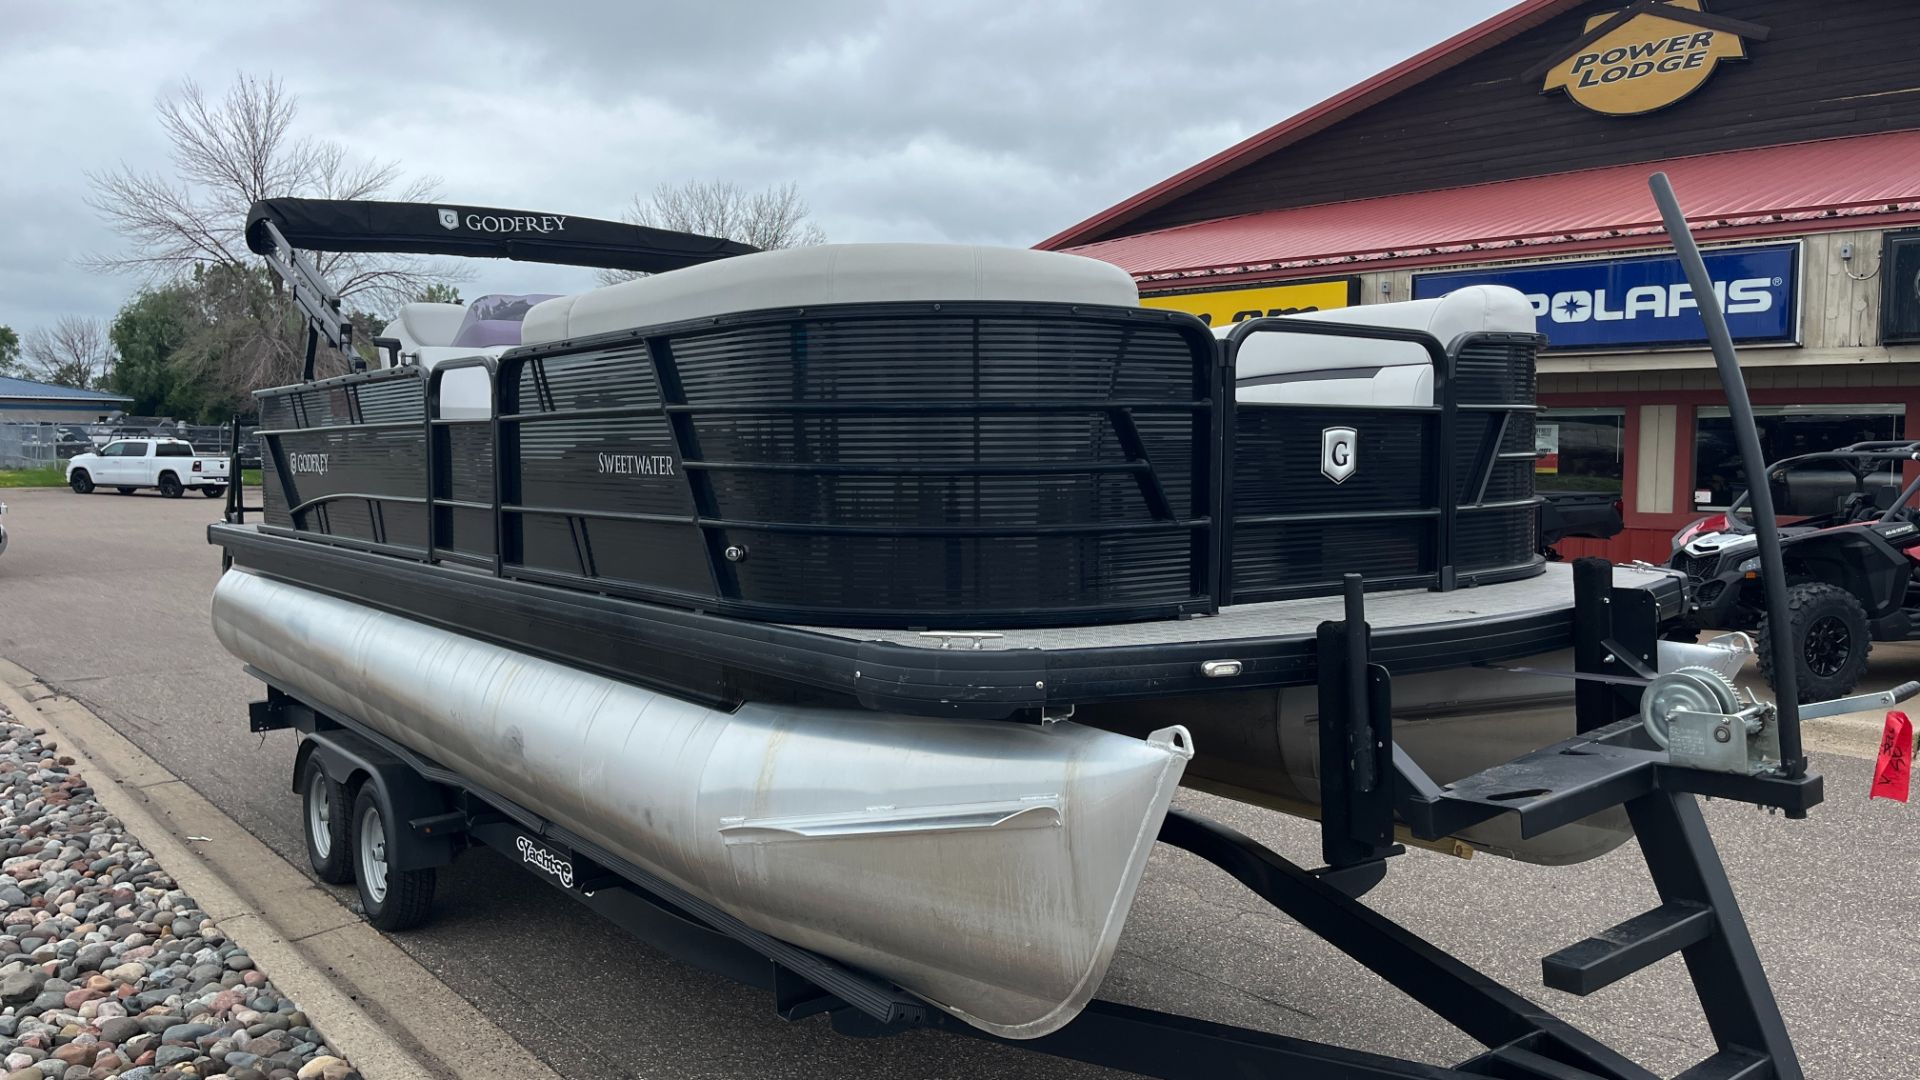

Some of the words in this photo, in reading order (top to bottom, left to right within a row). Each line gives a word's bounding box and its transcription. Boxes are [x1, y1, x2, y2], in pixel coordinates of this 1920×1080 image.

[1571, 31, 1714, 74] POWER
[1578, 50, 1708, 89] LODGE
[466, 214, 567, 234] GODFREY
[297, 453, 329, 476] GODFREY
[1331, 440, 1350, 467] G
